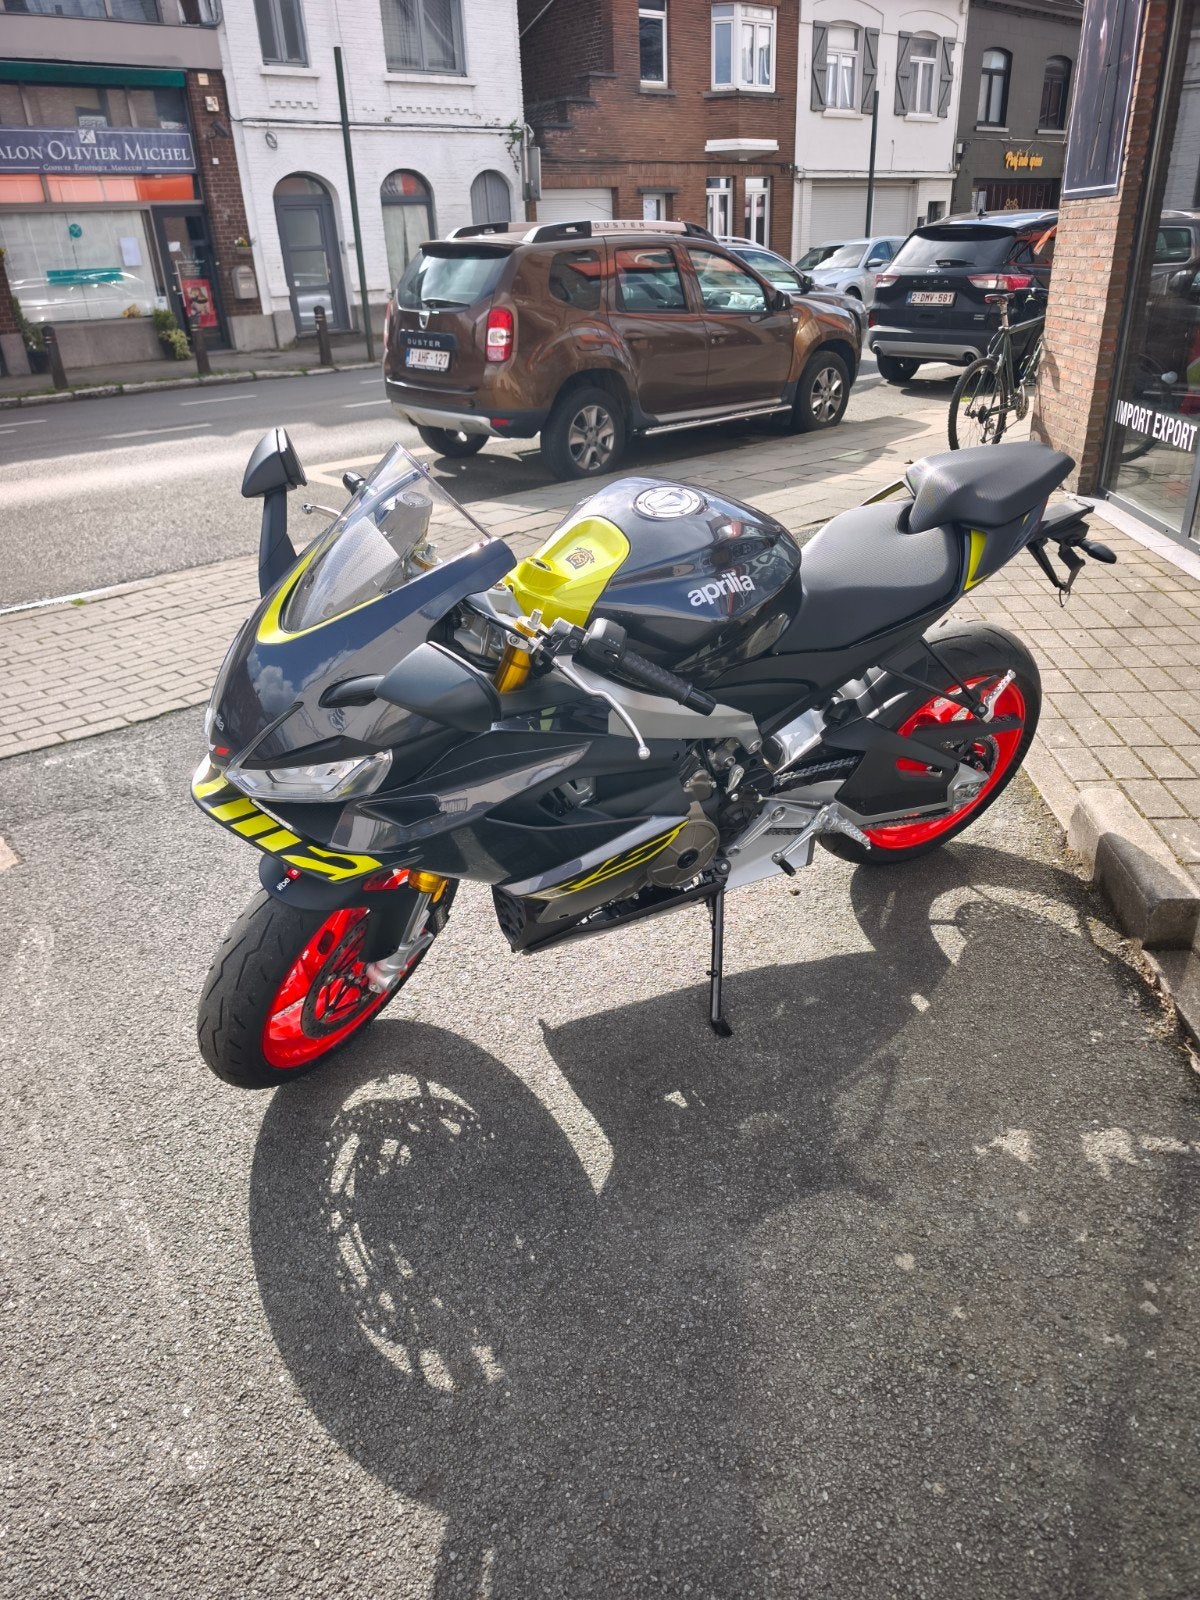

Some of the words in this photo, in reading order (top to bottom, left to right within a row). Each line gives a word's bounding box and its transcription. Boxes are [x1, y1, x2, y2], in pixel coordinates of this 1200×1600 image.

[48, 140, 121, 160] OLIVIER
[124, 142, 191, 161] MICHEL
[407, 338, 441, 348] DUSTER
[1115, 400, 1153, 434] IMPORT
[1152, 413, 1198, 452] EXPORT
[687, 571, 756, 607] aprilia
